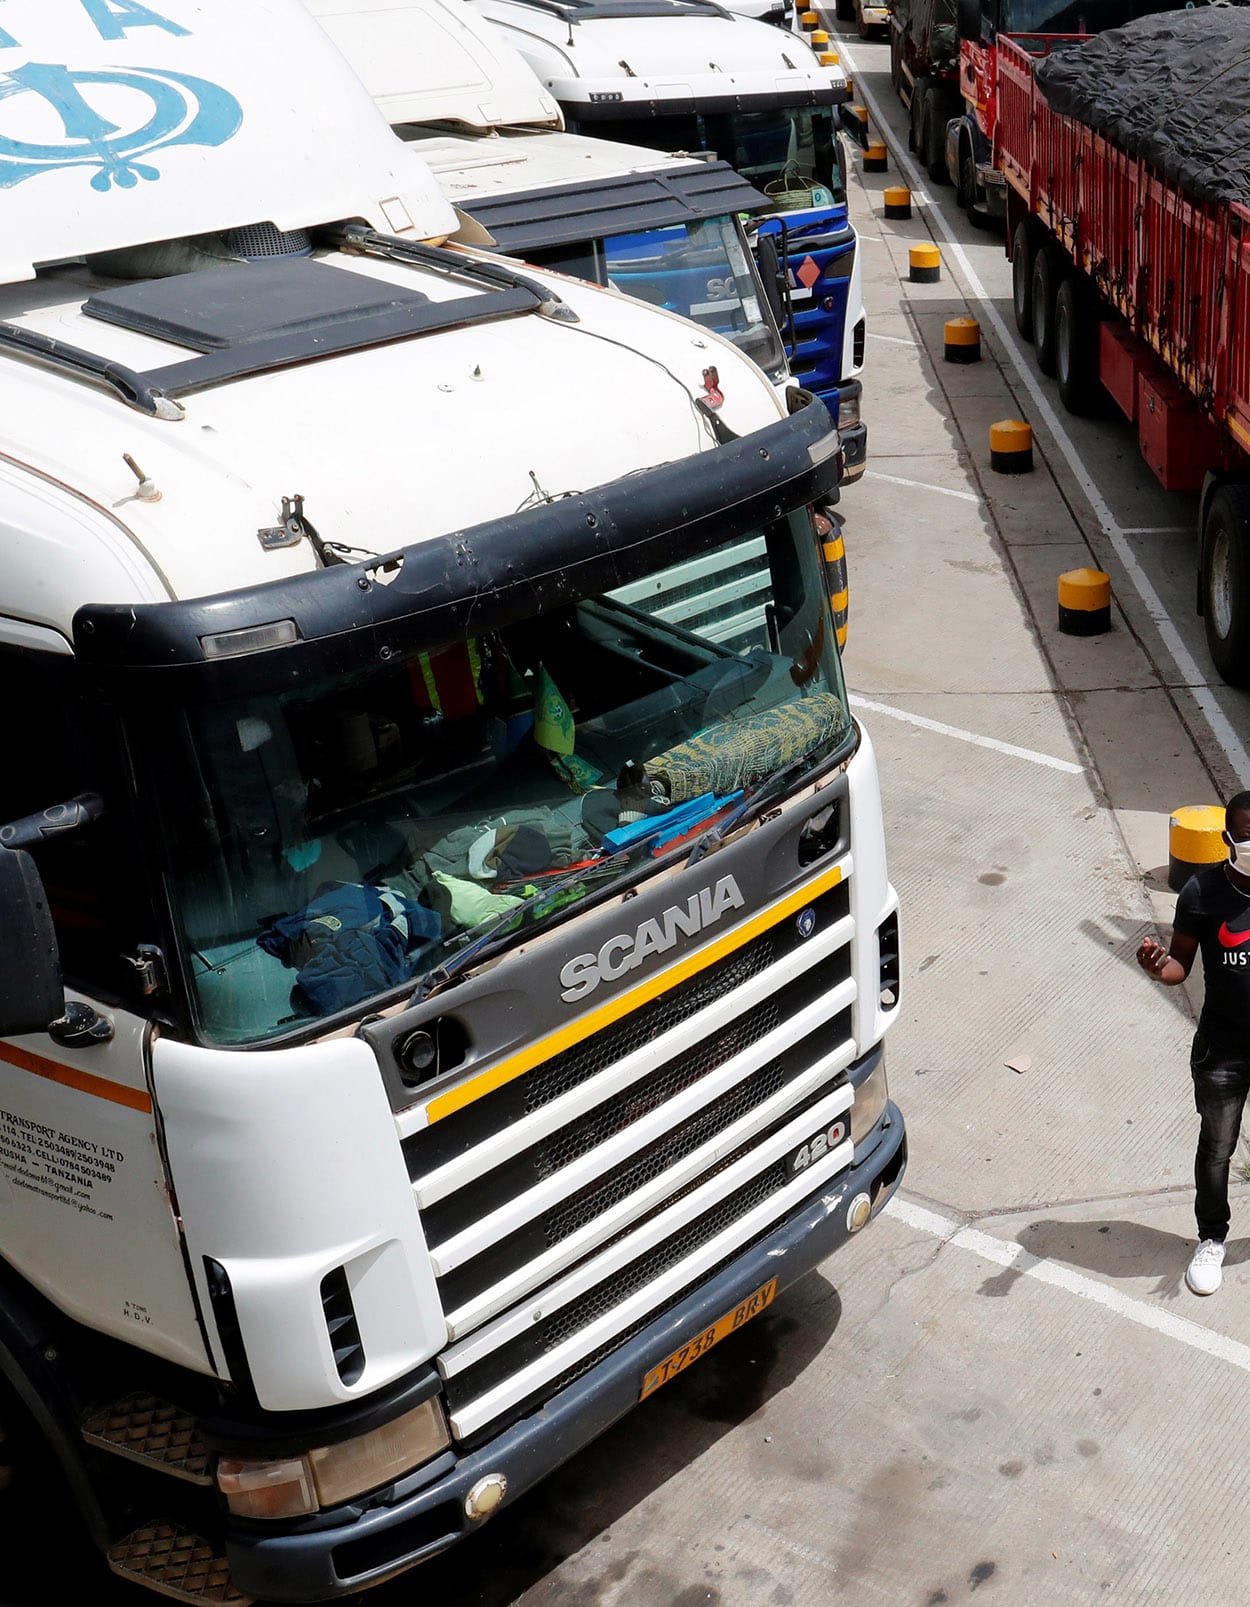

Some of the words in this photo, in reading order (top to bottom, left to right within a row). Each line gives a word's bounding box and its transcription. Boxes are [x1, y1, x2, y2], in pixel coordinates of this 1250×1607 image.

[560, 873, 746, 1004] SCANIA
[0, 1109, 56, 1140] TRANSPORT
[58, 1132, 98, 1154] AGENCY
[101, 1147, 124, 1162] LTD
[793, 1121, 846, 1171] 420
[45, 1164, 93, 1189] TANZANIA
[732, 1284, 772, 1330] BRY
